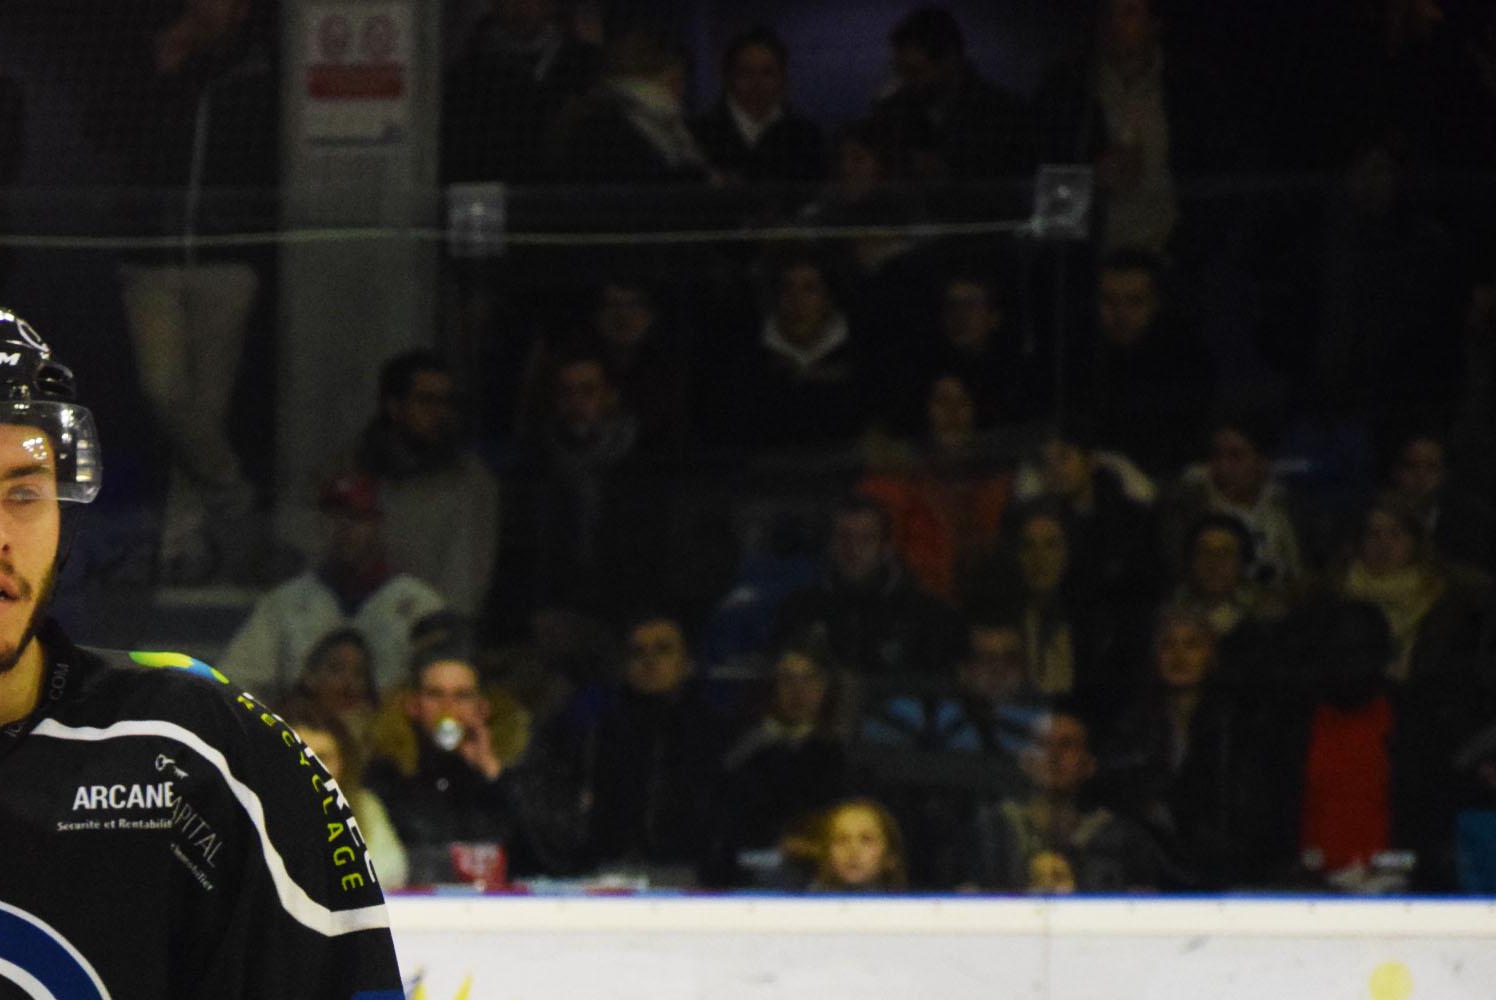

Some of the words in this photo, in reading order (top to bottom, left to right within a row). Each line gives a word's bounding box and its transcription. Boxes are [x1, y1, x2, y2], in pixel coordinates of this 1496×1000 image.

[72, 781, 174, 811] ARCANE
[118, 817, 173, 831] Rentabilit
[172, 796, 223, 868] APITAL
